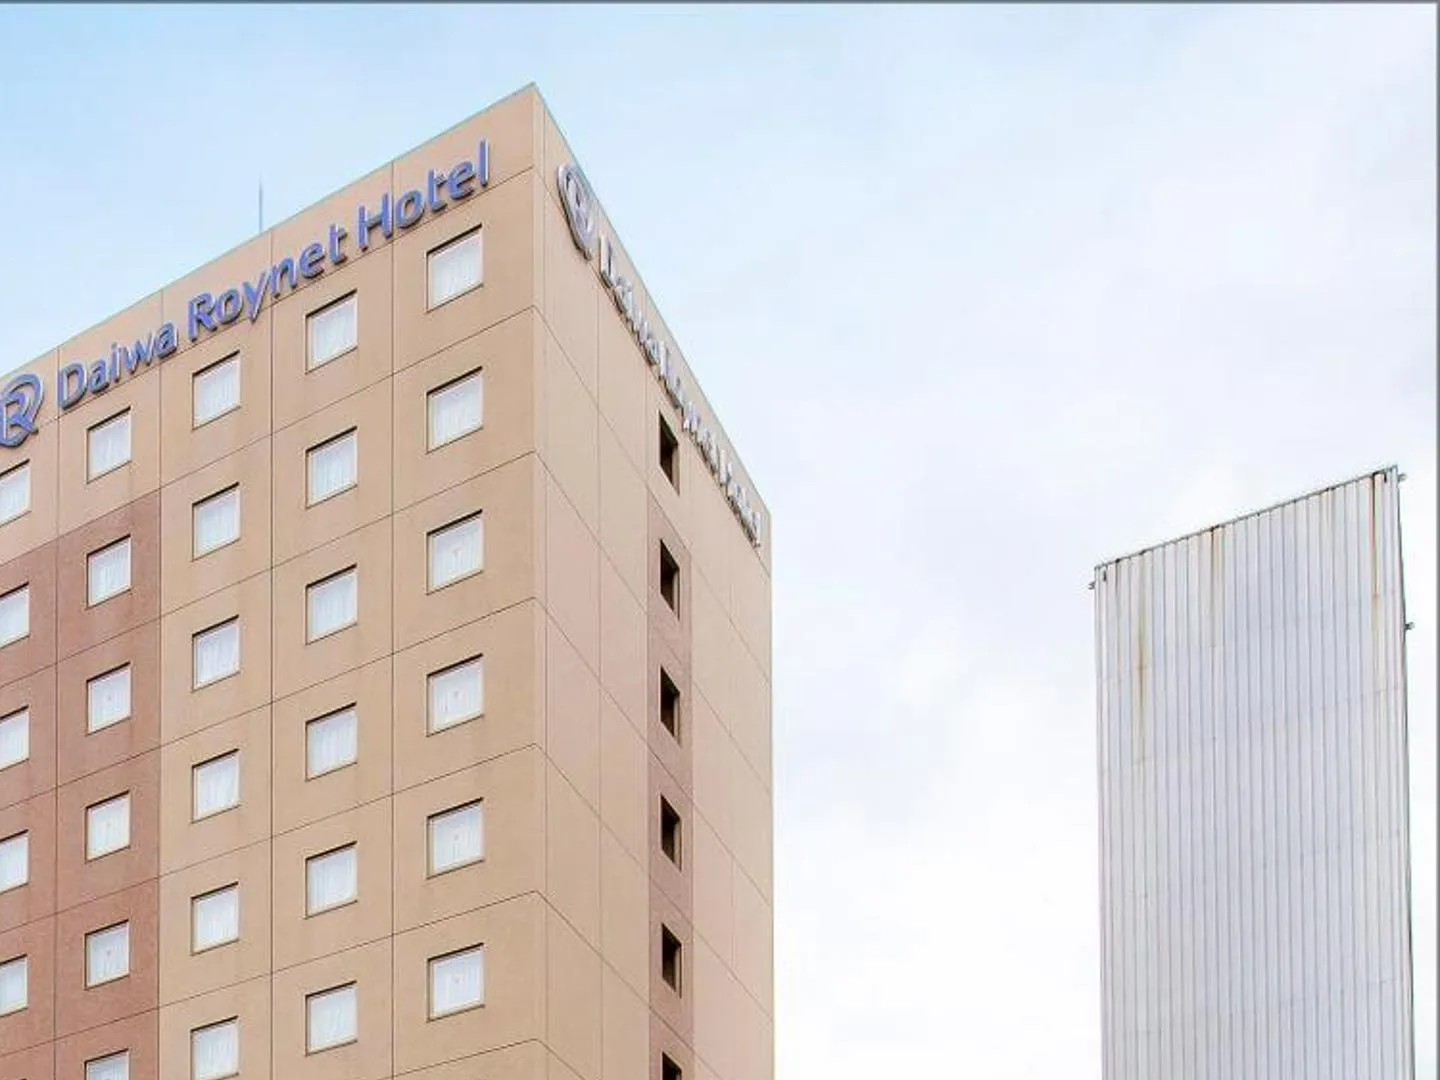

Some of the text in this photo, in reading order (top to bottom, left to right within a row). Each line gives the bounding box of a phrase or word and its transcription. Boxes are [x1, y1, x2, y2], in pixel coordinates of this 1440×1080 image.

[58, 319, 180, 411] Daiwa
[187, 223, 348, 342] Roynet
[357, 138, 491, 252] Hotel
